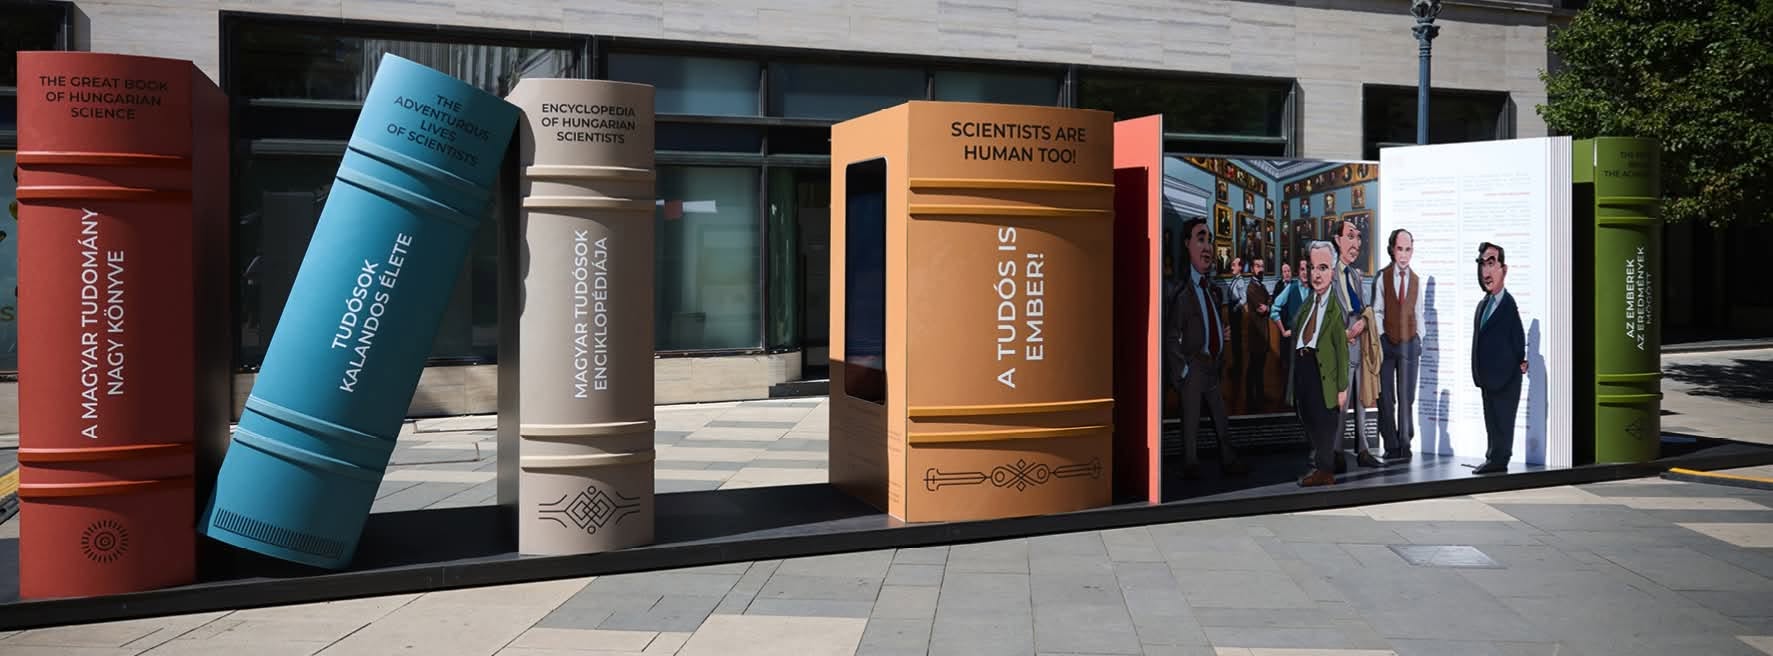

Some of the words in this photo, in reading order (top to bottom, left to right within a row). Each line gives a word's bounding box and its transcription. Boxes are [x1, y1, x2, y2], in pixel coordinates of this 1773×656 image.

[39, 76, 66, 87] THE
[70, 76, 121, 88] GREAT
[124, 79, 169, 91] BOOK
[46, 91, 65, 102] OF
[69, 92, 161, 106] HUNGARIAN
[71, 107, 136, 120] SCIENCE
[393, 95, 490, 142] ADVENTUROUS
[437, 95, 463, 113] THE
[542, 103, 636, 117] ENCYCLOPEDIA
[420, 119, 457, 142] LIVES
[541, 117, 559, 127] OF
[562, 118, 636, 131] HUNGARIAN
[557, 131, 625, 144] SCIENTISTS
[951, 121, 1051, 141] SCIENTISTS
[1055, 127, 1087, 142] ARE
[386, 123, 407, 136] OF
[407, 130, 479, 167] SCIENTISTS
[964, 145, 1033, 162] HUMAN
[1038, 147, 1077, 164] TOO!
[997, 226, 1017, 251] IS
[77, 207, 98, 328] TUDOMÁNY
[571, 229, 588, 319] TUDÓSOK
[103, 250, 124, 333] KÖNYVE
[331, 258, 379, 349] TUDÓSOK
[1626, 259, 1635, 319] EMBEREK
[1636, 247, 1645, 331] EREDMÉNYEK
[339, 291, 390, 393] KALANDOS
[378, 232, 413, 289] ÉLETE
[591, 236, 608, 391] ENCIKLOPÉDIÁJA
[993, 260, 1017, 361] TUDÓS
[1025, 252, 1044, 361] EMBER!
[1626, 321, 1635, 338] AZ
[1637, 334, 1645, 351] AZ
[81, 332, 98, 419] MAGYAR
[107, 339, 124, 395] NAGY
[574, 322, 588, 398] MAGYAR
[996, 367, 1016, 389] A
[81, 424, 98, 439] A
